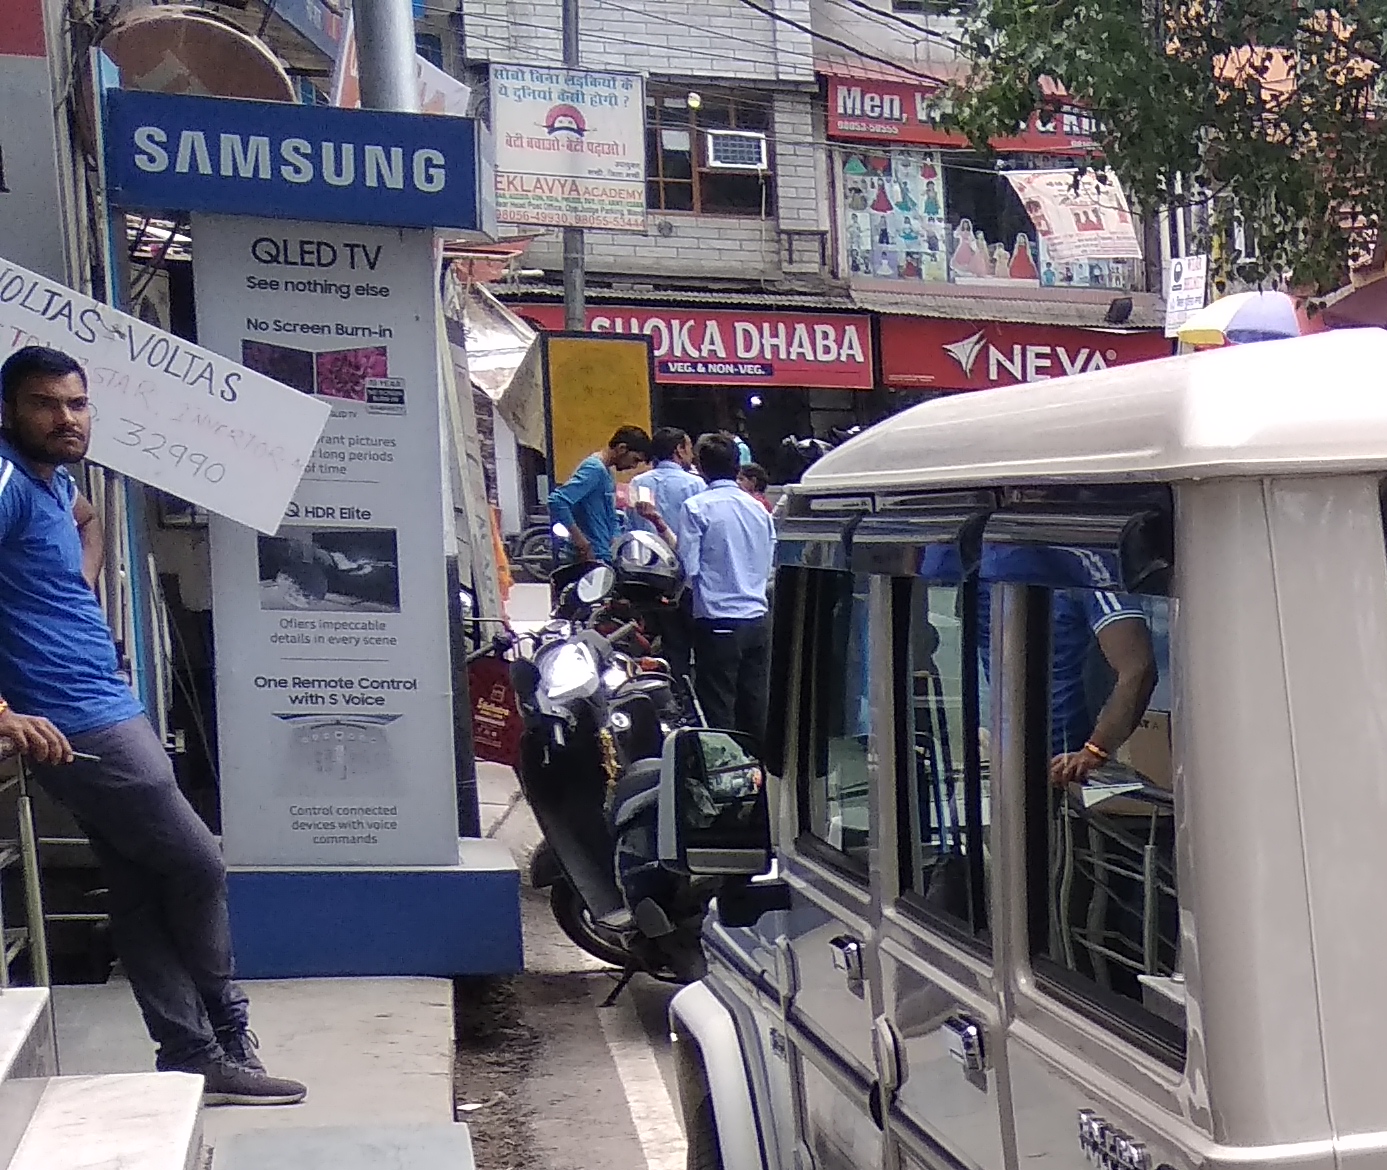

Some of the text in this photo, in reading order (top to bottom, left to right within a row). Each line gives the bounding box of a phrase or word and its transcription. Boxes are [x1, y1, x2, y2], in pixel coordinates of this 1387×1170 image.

[836, 85, 908, 122] Men,
[134, 126, 446, 193] SAMSUNG
[494, 174, 581, 197] EKLAVYA
[582, 187, 643, 200] ACADEMY
[251, 237, 383, 270] QLED TV
[246, 276, 390, 299] See nothing else
[246, 318, 393, 339] No Screen Burn-in
[734, 321, 864, 363] DHABA
[127, 324, 244, 403] VOLTAS
[668, 362, 766, 376] VEG. & NON-VEG.
[348, 435, 396, 449] pictures
[318, 449, 346, 462] long
[348, 450, 394, 462] periods
[319, 464, 347, 475] time
[305, 507, 336, 520] HDR
[339, 507, 372, 520] Elite
[279, 619, 386, 632] Offers impeccable
[270, 633, 397, 648] details in every scene
[254, 676, 418, 691] One Remote Control
[289, 693, 386, 706] with S Voice
[289, 805, 398, 817] Control connected
[291, 819, 398, 831] devices with voice
[313, 833, 378, 844] commands
